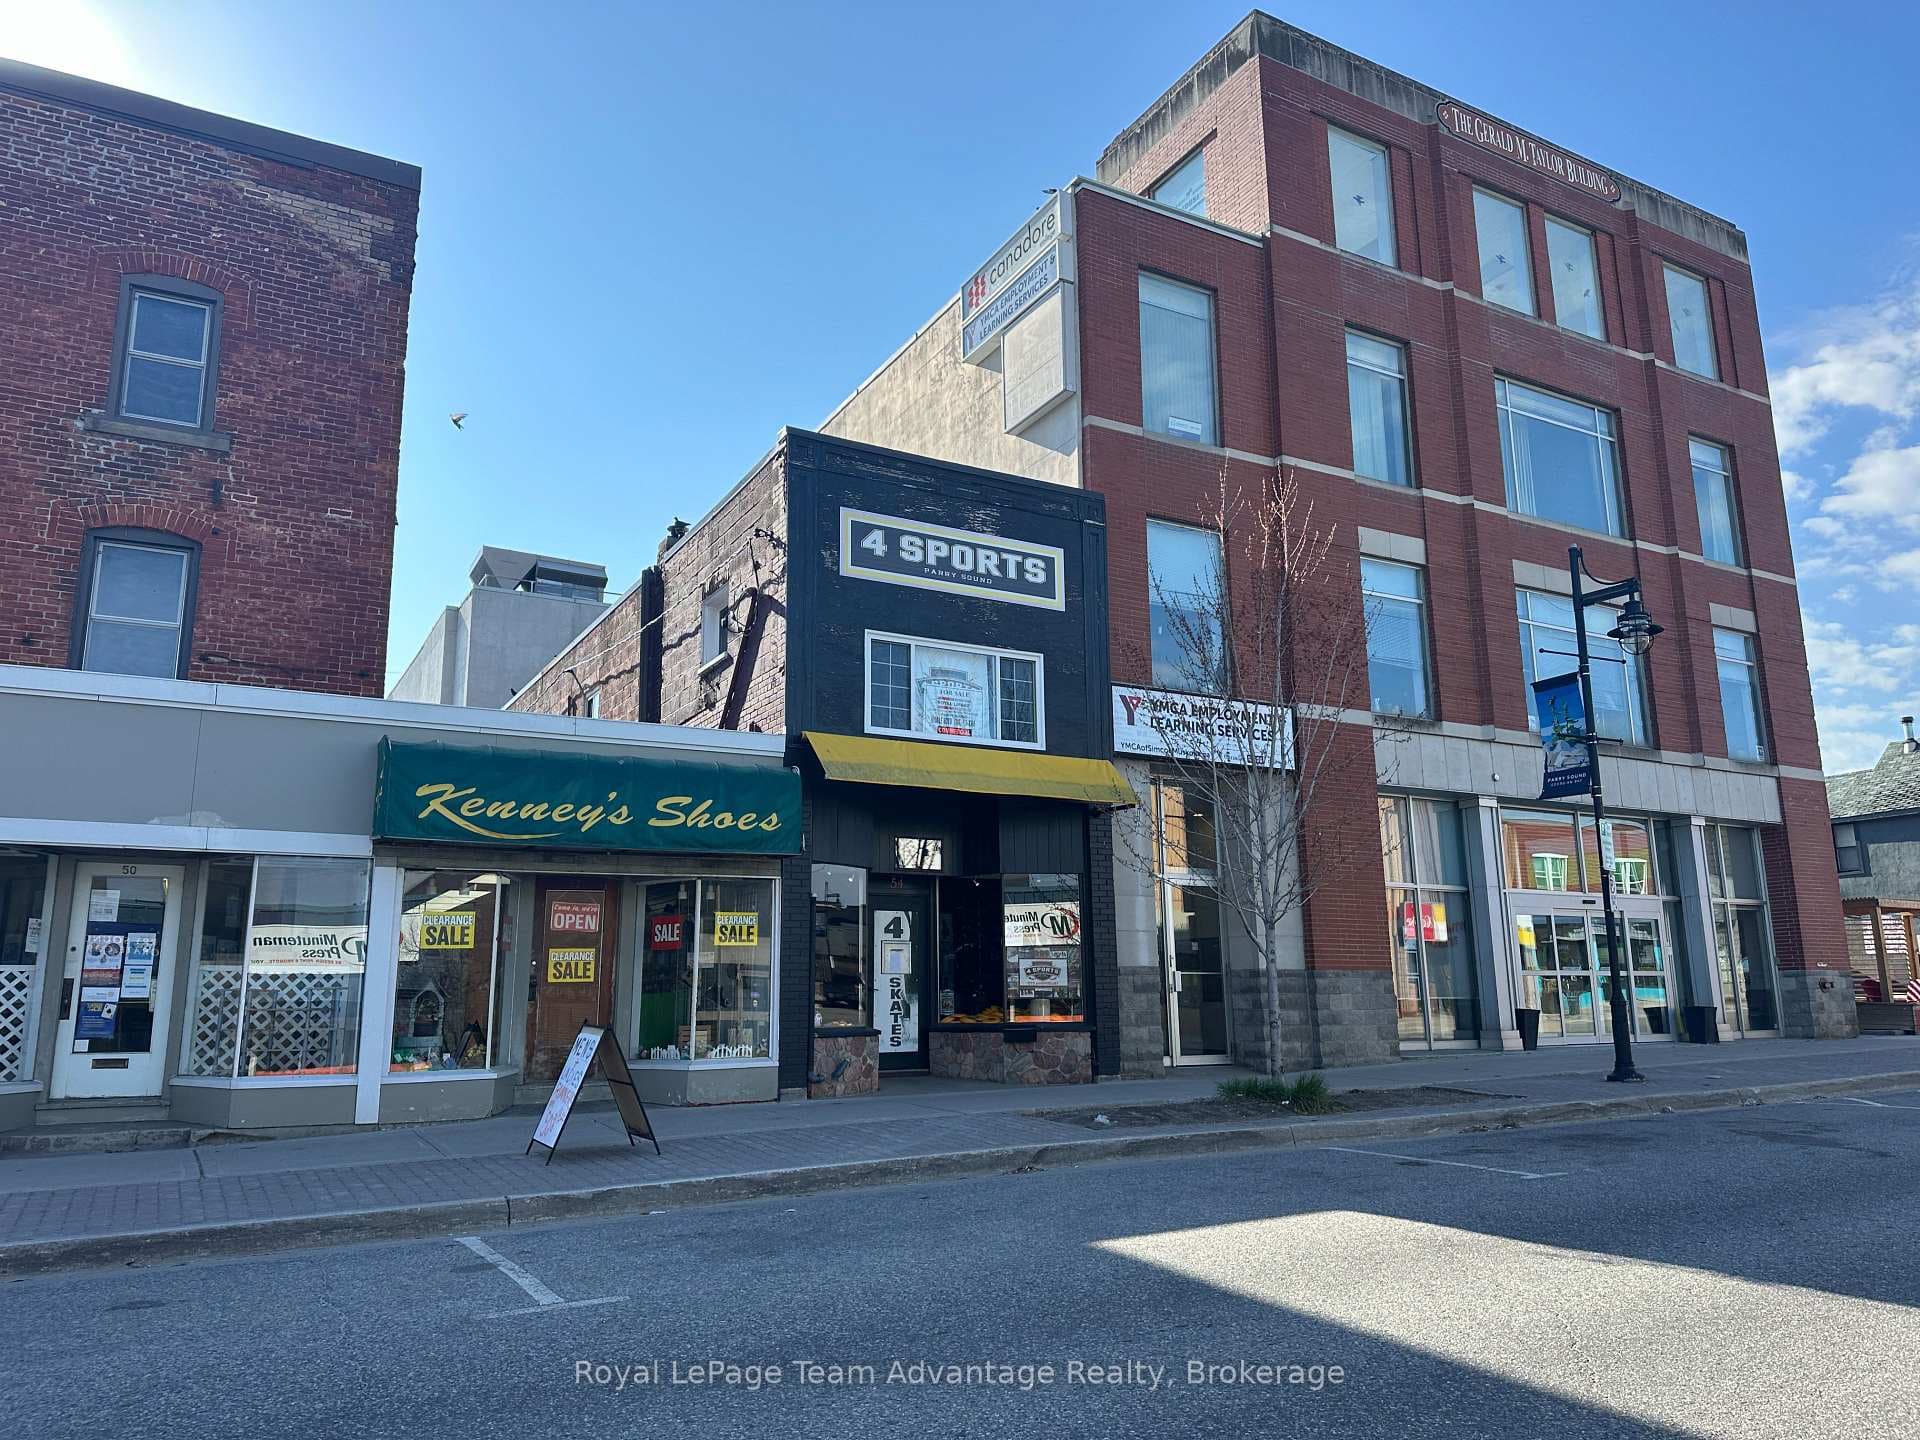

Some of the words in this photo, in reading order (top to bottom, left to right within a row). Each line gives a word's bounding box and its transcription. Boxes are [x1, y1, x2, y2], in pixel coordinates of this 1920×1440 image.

[1515, 136, 1529, 162] M.
[989, 212, 1055, 285] canadore
[980, 304, 1000, 327] YMCA
[1000, 258, 1049, 310] EMPLOYMENT
[1050, 254, 1056, 265] &
[979, 304, 1014, 340] LEARNING
[1014, 273, 1049, 310] SERVICES
[861, 528, 888, 558] 4
[899, 534, 1047, 584] SPORTS
[924, 567, 956, 579] PARRY
[961, 573, 993, 585] SOUND
[1151, 699, 1188, 716] YMCA
[415, 783, 634, 840] Kenney's
[648, 795, 782, 832] Shoes
[122, 865, 137, 875] 50
[423, 915, 473, 926] CLEARANCE
[554, 913, 597, 930] OPEN
[717, 915, 757, 925] CLEARANCE
[884, 916, 904, 939] 4
[425, 926, 470, 946] SALE
[654, 923, 681, 942] SALE
[718, 925, 755, 943] SALE
[551, 951, 594, 961] CLEARANCE
[553, 961, 592, 979] SALE
[889, 977, 903, 1047] SKATES
